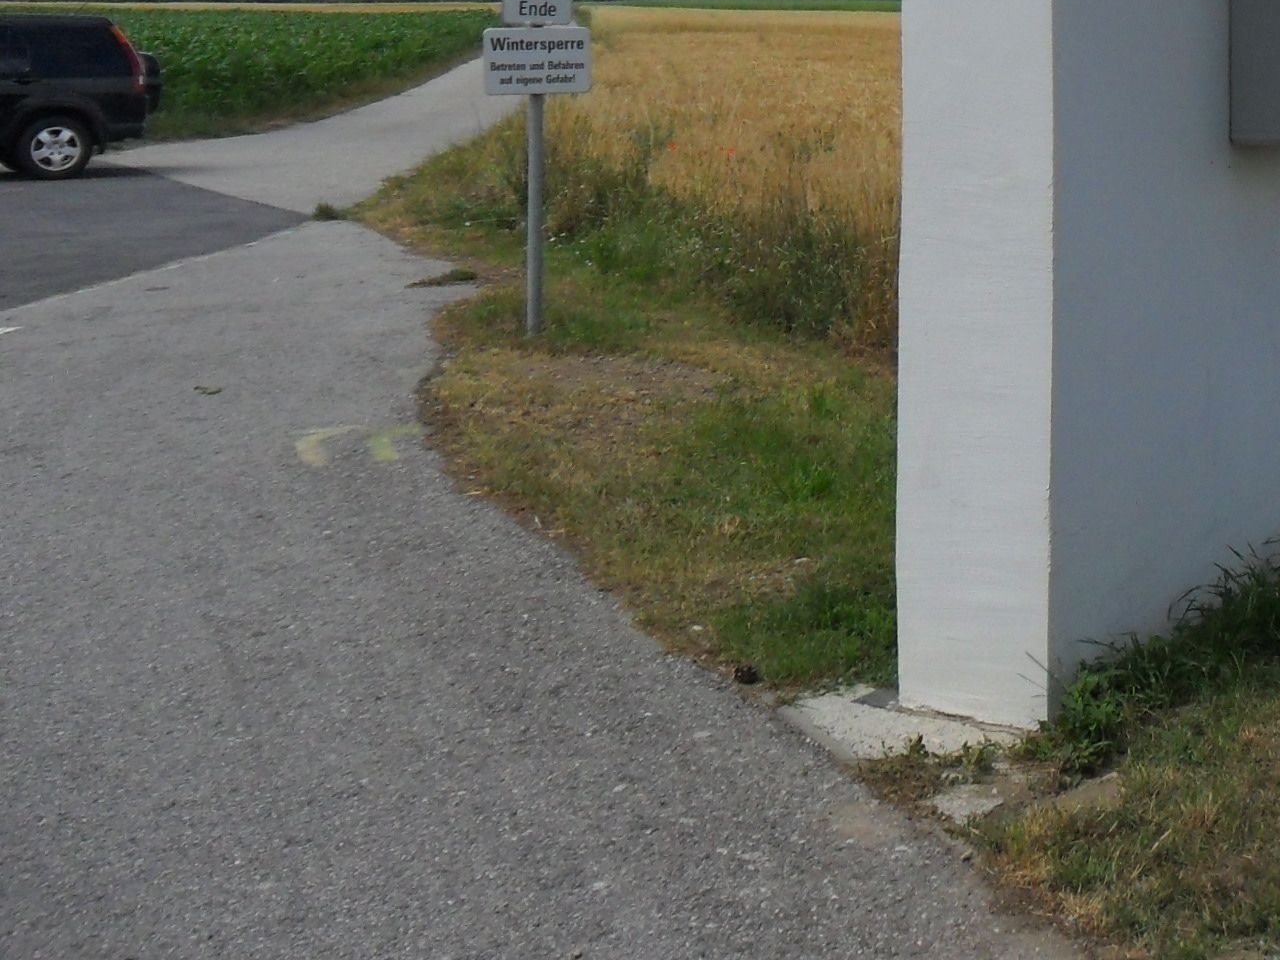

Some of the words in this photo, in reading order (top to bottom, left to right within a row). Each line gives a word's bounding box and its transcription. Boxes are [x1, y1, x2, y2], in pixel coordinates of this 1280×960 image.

[519, 0, 557, 17] Ende
[490, 37, 584, 53] Wintersperre
[490, 62, 526, 71] Betreten
[529, 61, 545, 70] und
[547, 60, 585, 70] Befahren
[500, 76, 512, 85] auf
[516, 76, 542, 86] eigene
[546, 74, 576, 84] Gefahr!
